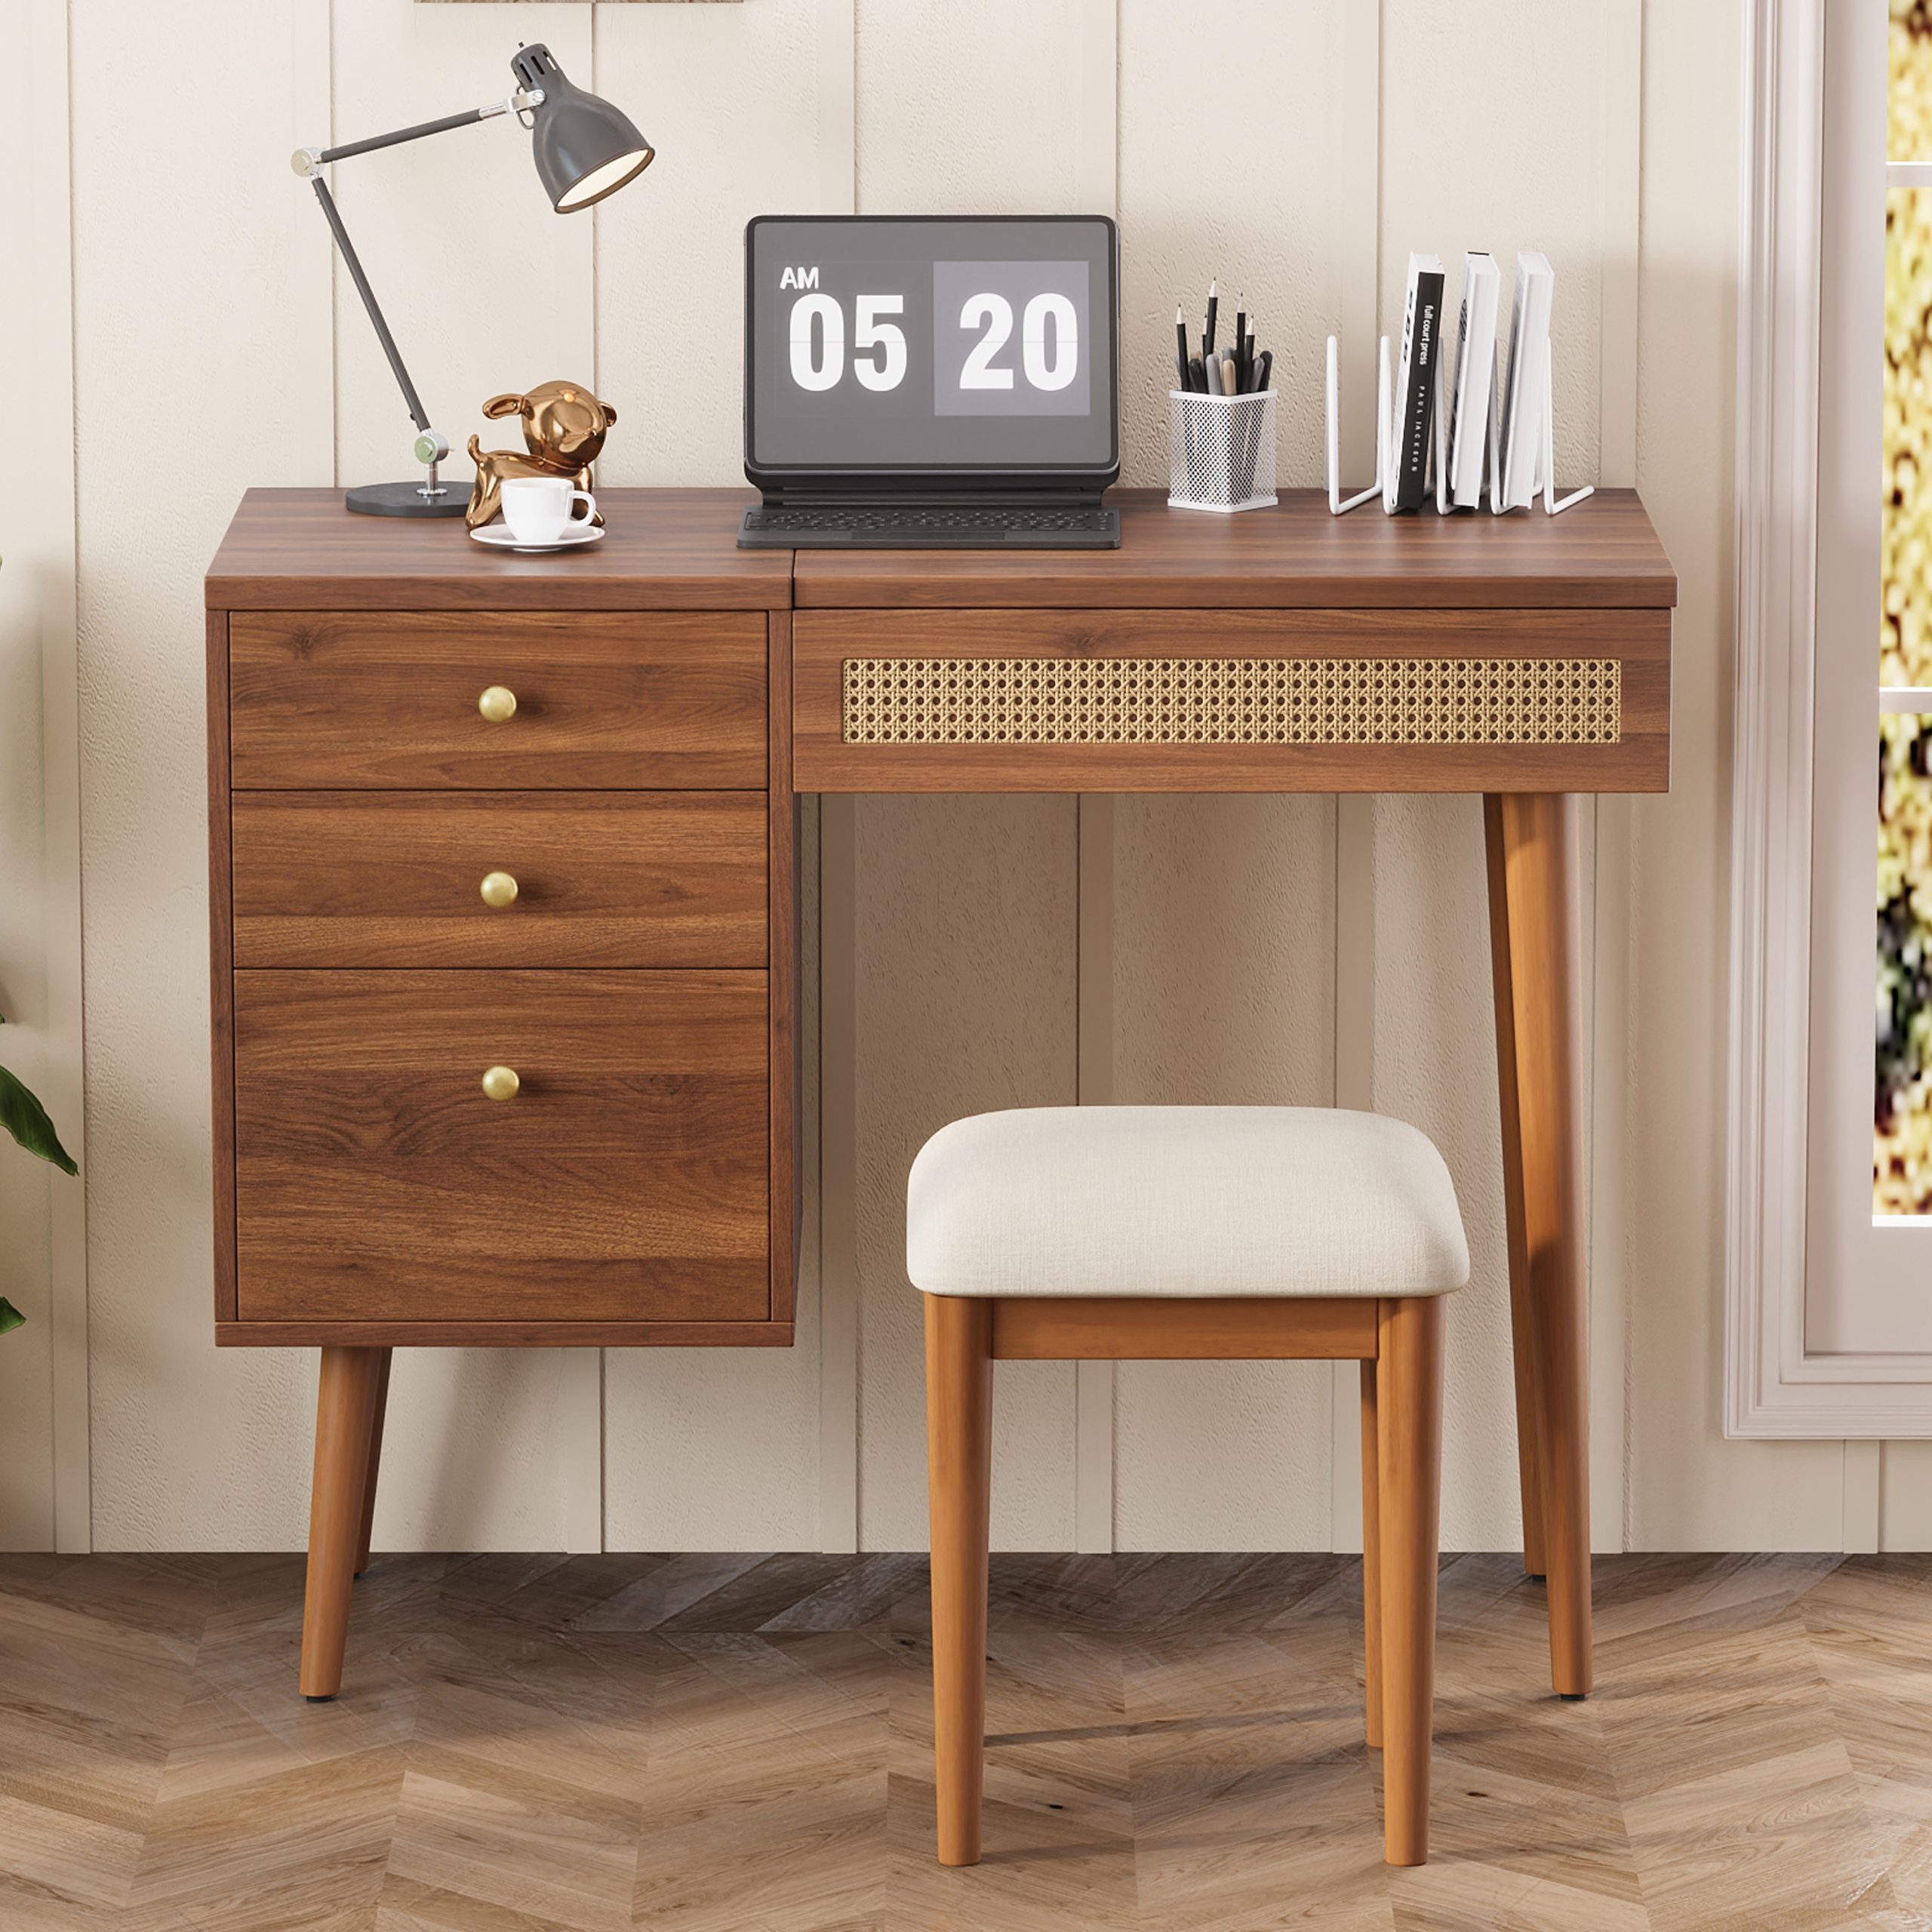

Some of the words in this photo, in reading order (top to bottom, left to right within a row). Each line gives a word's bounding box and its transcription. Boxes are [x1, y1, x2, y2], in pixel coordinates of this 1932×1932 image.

[779, 266, 820, 290] AM
[1423, 304, 1435, 319] full
[789, 293, 907, 392] 05
[959, 293, 1078, 392] 20
[1421, 319, 1431, 342] court
[1419, 342, 1429, 365] press
[1417, 385, 1426, 414] PAUL
[1411, 420, 1422, 472] JACKSON
